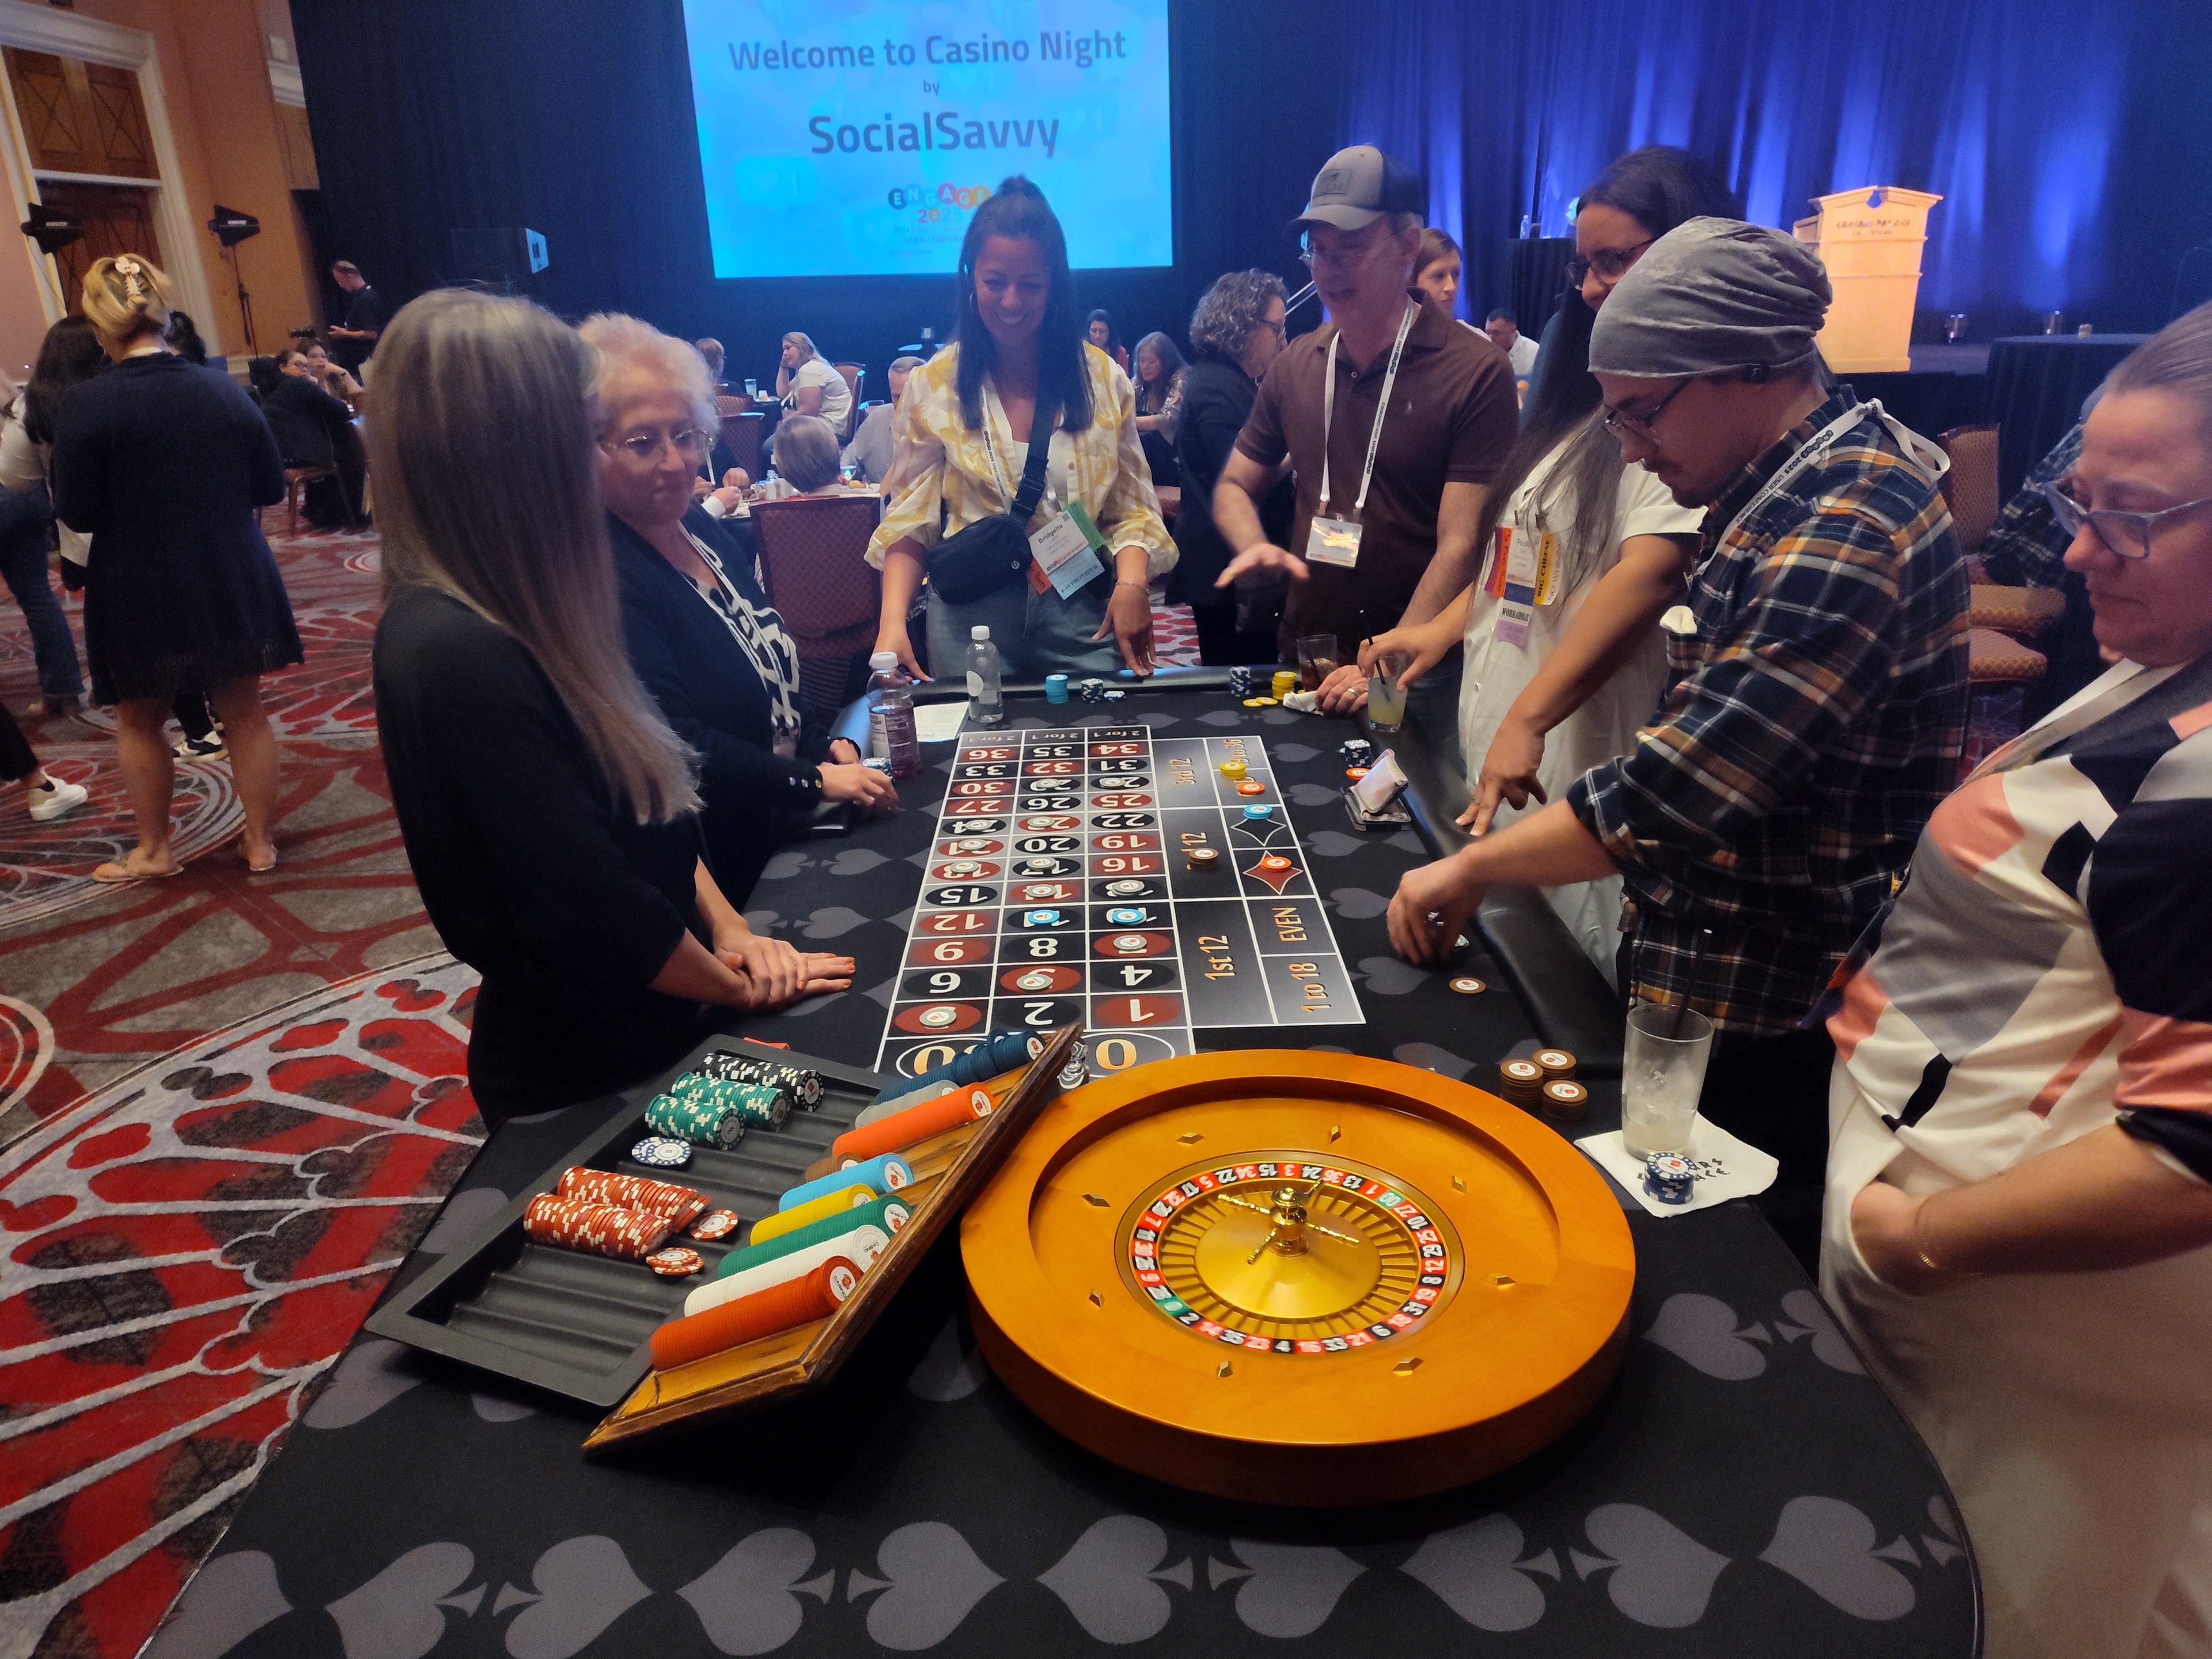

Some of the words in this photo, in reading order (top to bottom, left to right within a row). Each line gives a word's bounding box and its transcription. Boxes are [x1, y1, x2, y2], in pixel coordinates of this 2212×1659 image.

[728, 40, 875, 71] Welcome
[885, 39, 916, 66] to
[926, 35, 1029, 65] Casino
[1040, 30, 1126, 68] Night
[923, 80, 940, 96] by
[809, 112, 1059, 157] SocialSavvy
[889, 183, 991, 209] ENGAGE
[918, 208, 963, 223] 2025
[1784, 458, 1802, 475] 2025
[1768, 475, 1784, 491] USER
[1736, 490, 1769, 524] CONFERENCE
[1037, 524, 1063, 544] Bridgette
[1541, 540, 1550, 577] CHEESE
[1071, 564, 1099, 586] PROVIDER
[1548, 585, 1556, 601] NO
[1098, 743, 1138, 755] 34
[1222, 738, 1245, 748] 36
[968, 748, 1009, 760] 36
[1033, 746, 1073, 757] 35
[1032, 762, 1073, 774] 32
[1100, 759, 1138, 771] 31
[1169, 757, 1193, 768] 12
[965, 764, 1006, 777] 33
[1169, 770, 1196, 785] 3rd
[960, 782, 1005, 794] 30
[955, 800, 1002, 813] 27
[1027, 797, 1070, 810] 26
[1099, 794, 1143, 807] 25
[1101, 813, 1146, 827] 22
[1024, 837, 1071, 852] 20
[1101, 835, 1148, 849] 19
[1181, 832, 1207, 846] 12
[1102, 857, 1150, 872] 16
[940, 888, 988, 904] 15
[933, 914, 985, 930] 12
[1271, 907, 1308, 942] EVEN
[933, 941, 964, 961] 9
[1028, 938, 1058, 957] 8
[1198, 935, 1230, 953] 12
[1119, 965, 1153, 986] 4
[1204, 956, 1236, 981] 1st
[1288, 963, 1320, 980] 18
[929, 971, 961, 994] 6
[1304, 983, 1328, 1000] to
[1023, 1002, 1055, 1025] 2
[1129, 999, 1155, 1022] 1
[1301, 1003, 1332, 1013] 1
[1096, 1039, 1137, 1070] 0
[889, 1165, 905, 1181] CASINO
[1258, 1164, 1278, 1178] 15
[1283, 1164, 1296, 1176] 3
[1301, 1165, 1323, 1179] 24
[1199, 1176, 1214, 1188] 5
[1343, 1175, 1363, 1190] 13
[1365, 1184, 1380, 1195] 1
[889, 1210, 907, 1221] CASINO
[1406, 1215, 1429, 1230] 10
[864, 1241, 880, 1253] CASINO
[1425, 1259, 1444, 1273] 12
[834, 1275, 847, 1298] CASINO
[1422, 1275, 1442, 1285] 8
[1179, 1312, 1200, 1324] 2
[1275, 1340, 1291, 1353] 4
